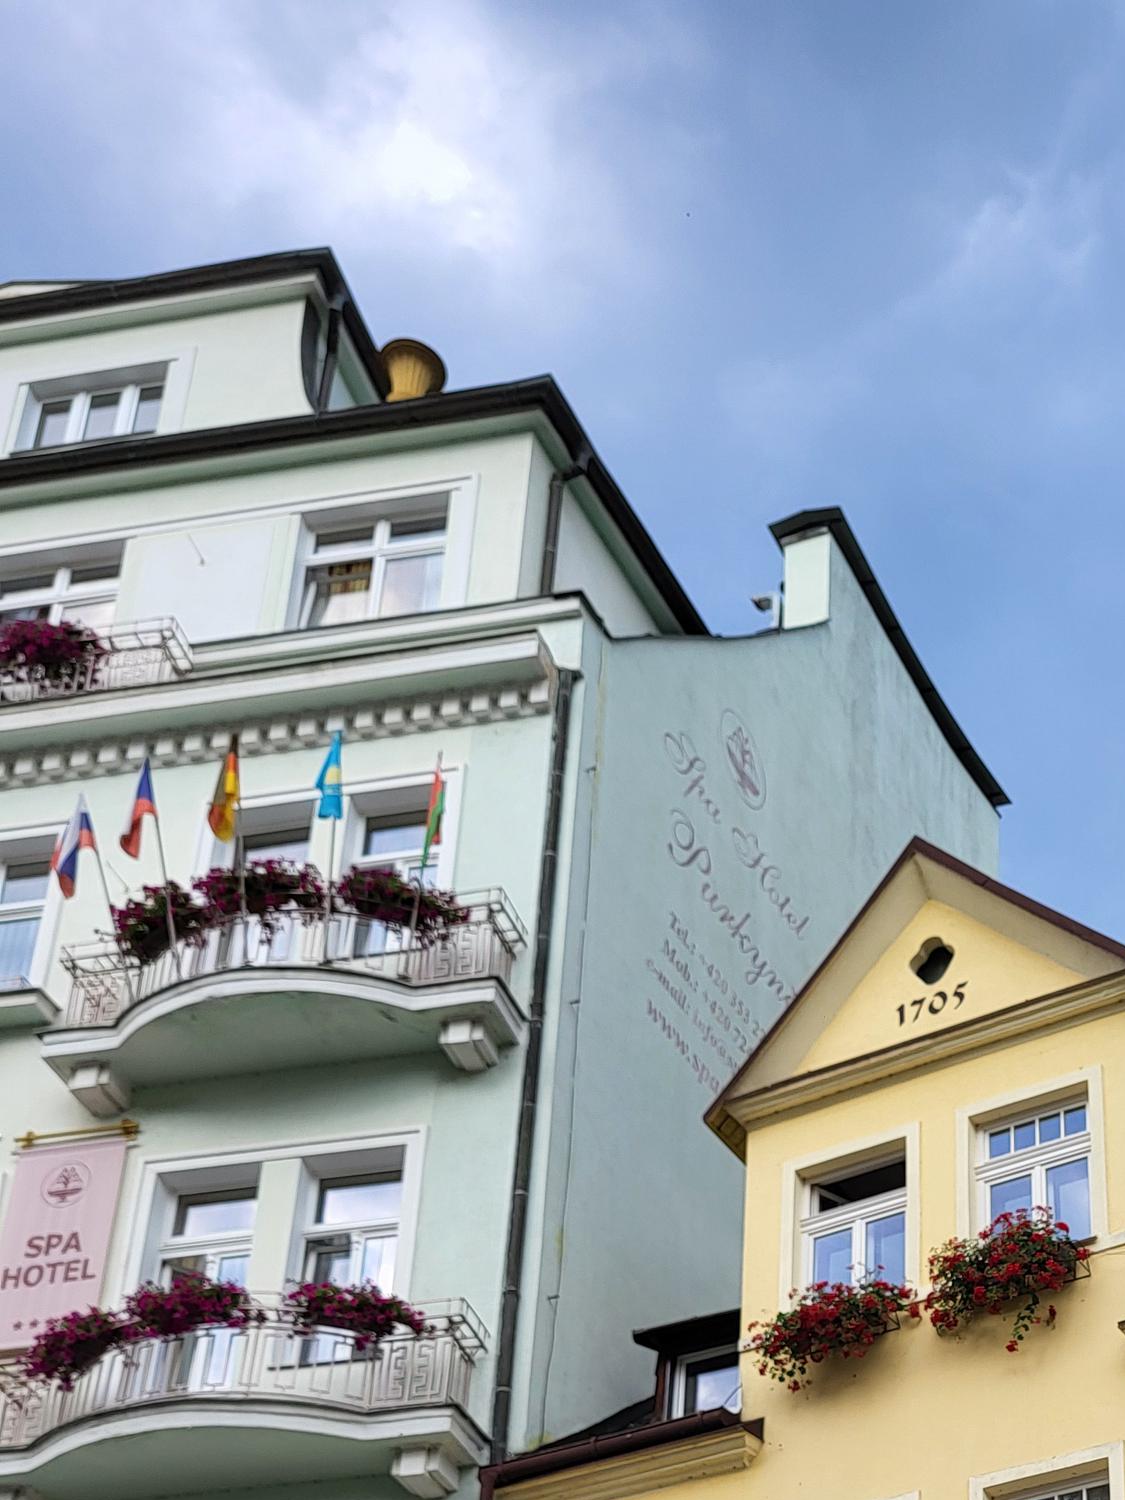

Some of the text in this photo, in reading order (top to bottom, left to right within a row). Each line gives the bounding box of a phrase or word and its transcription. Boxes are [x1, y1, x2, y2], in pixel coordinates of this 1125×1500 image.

[896, 980, 968, 1027] 1705
[24, 1232, 81, 1258] SPA
[0, 1258, 96, 1290] HOTEL
